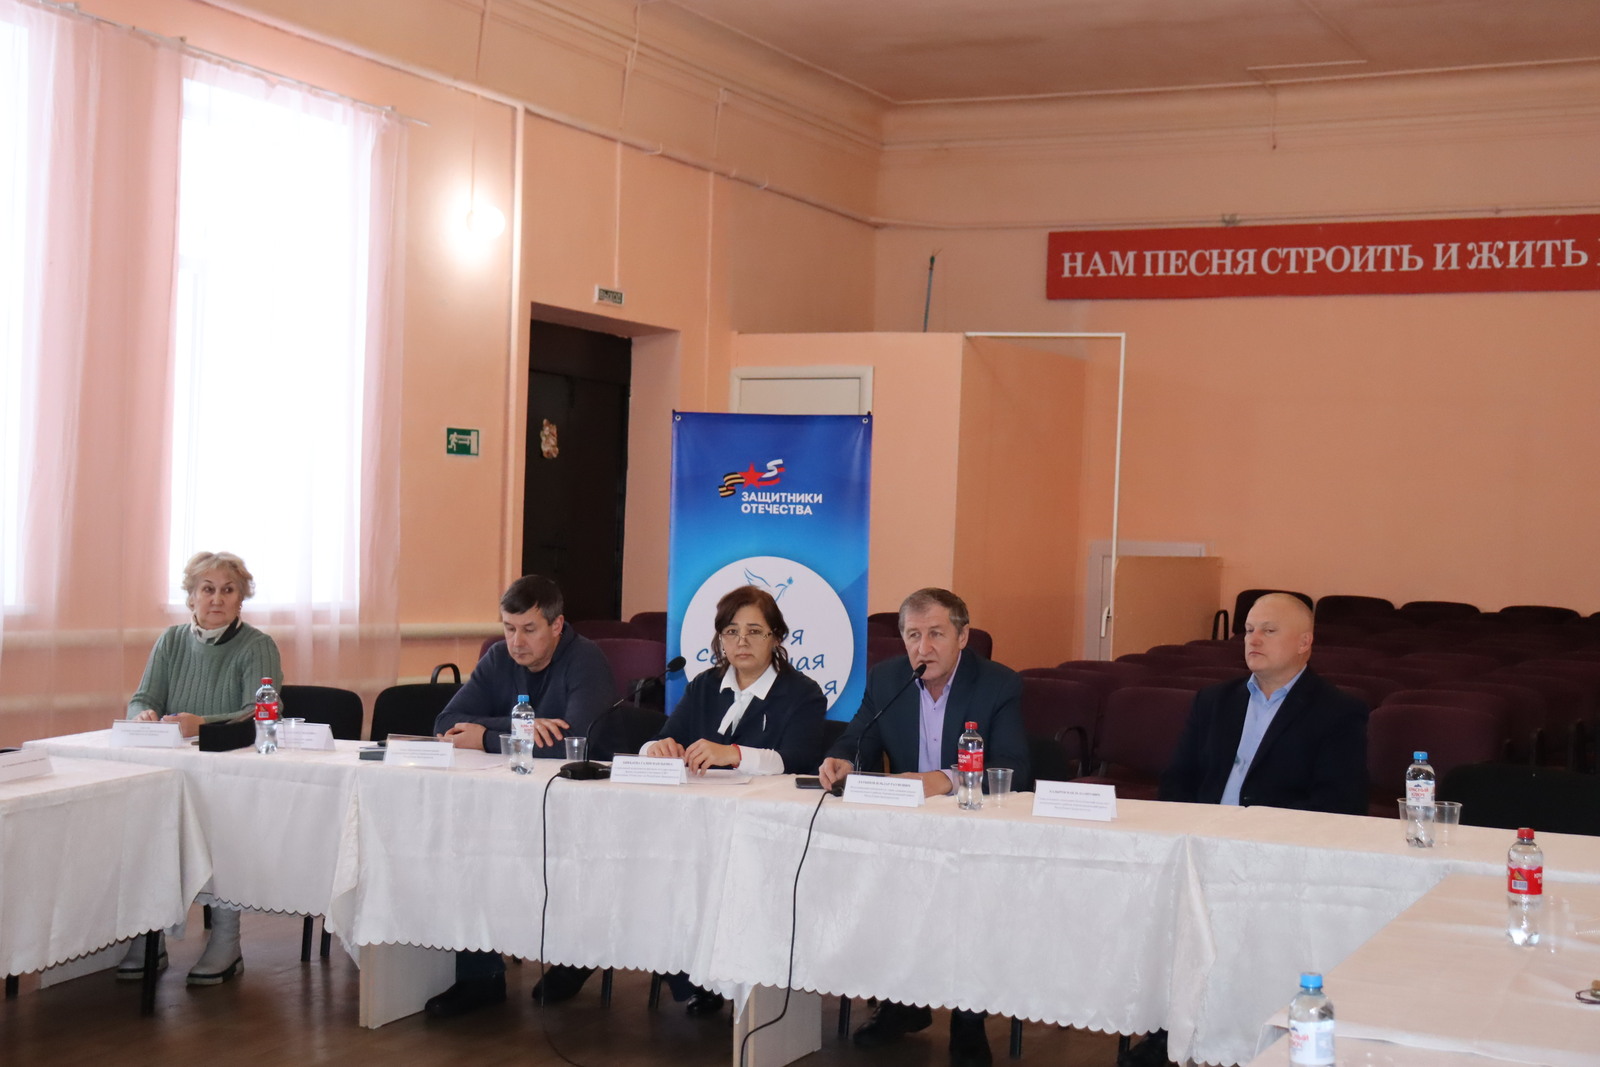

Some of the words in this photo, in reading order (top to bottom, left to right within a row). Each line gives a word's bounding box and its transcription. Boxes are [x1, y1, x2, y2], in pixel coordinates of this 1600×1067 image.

[1062, 250, 1137, 278] НАМ
[1143, 248, 1258, 277] ПЕСНЯ
[1260, 244, 1424, 275] СТРОИТЬ
[1432, 242, 1461, 271] И
[1467, 238, 1589, 270] ЖИТЬ
[741, 491, 823, 504] ЗАЩИТНИКИ
[740, 503, 813, 515] ОТЕЧЕСТВА
